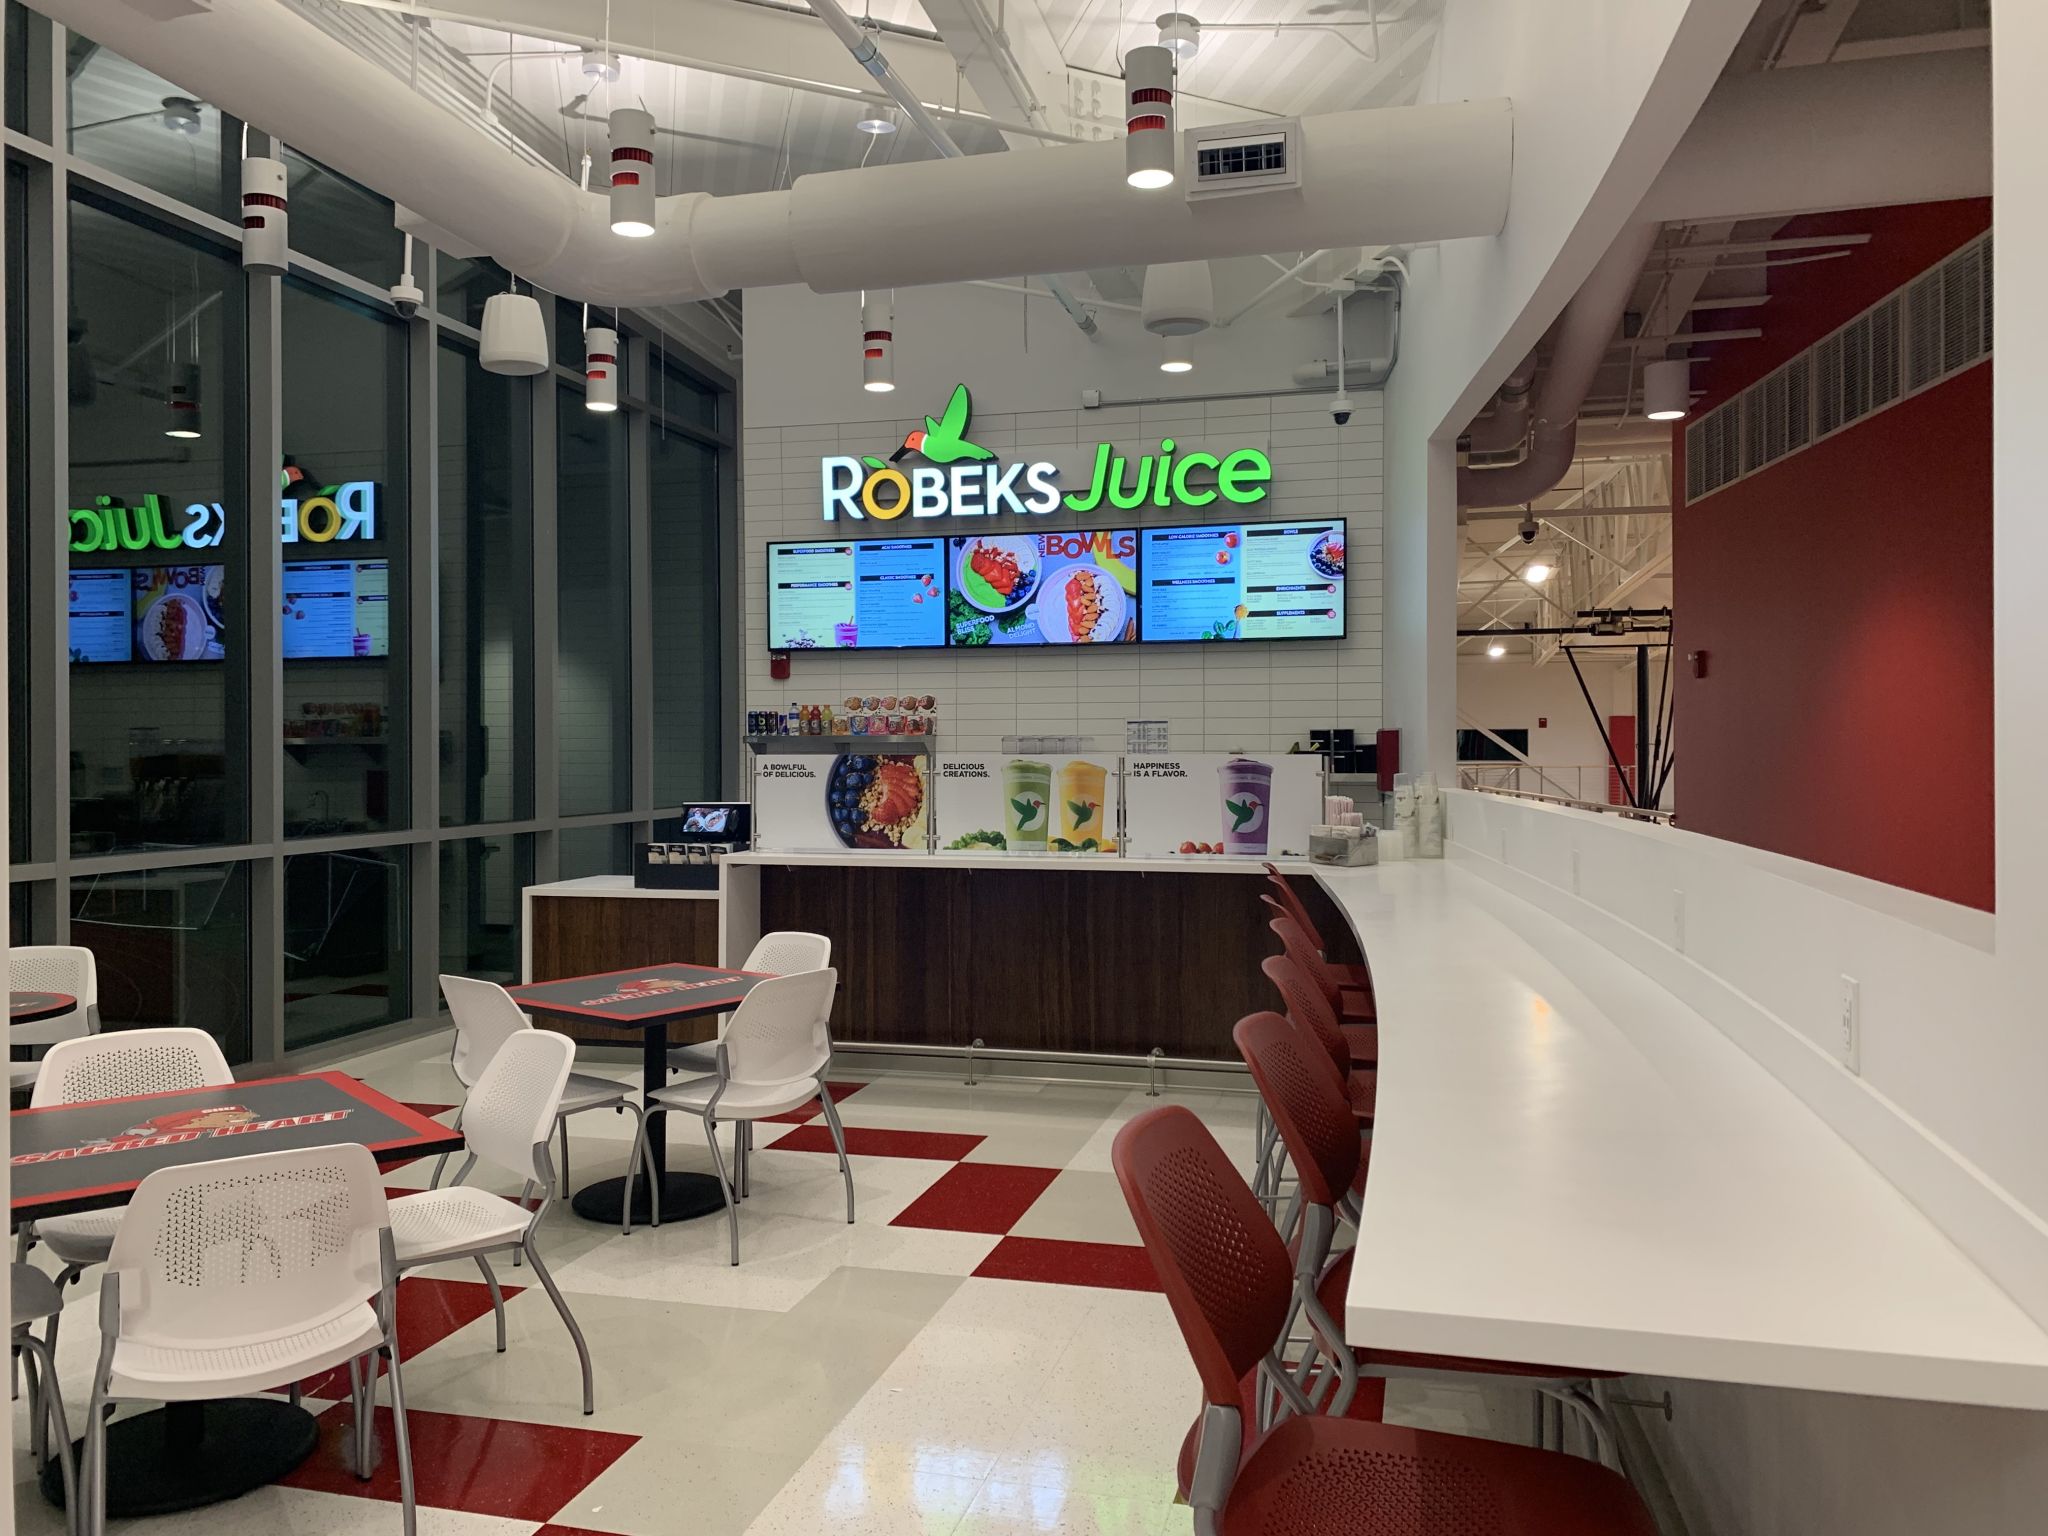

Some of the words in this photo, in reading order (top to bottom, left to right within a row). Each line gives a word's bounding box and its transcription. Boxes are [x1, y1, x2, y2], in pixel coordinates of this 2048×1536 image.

[821, 455, 1062, 522] ROBEKS
[1063, 438, 1272, 513] Juice
[1046, 531, 1136, 560] BOWLS
[955, 614, 995, 629] SUPERFOOD
[1007, 622, 1035, 634] ALMOND
[1133, 762, 1181, 770] HAPPINESS
[775, 770, 817, 778] DELICIOUS.
[943, 770, 990, 778] CREATIONS.
[1133, 770, 1142, 778] IS
[1143, 770, 1151, 778] A
[1152, 770, 1189, 778] FLAVOR.
[11, 1129, 201, 1166] SACRED
[212, 1108, 352, 1138] HEART
